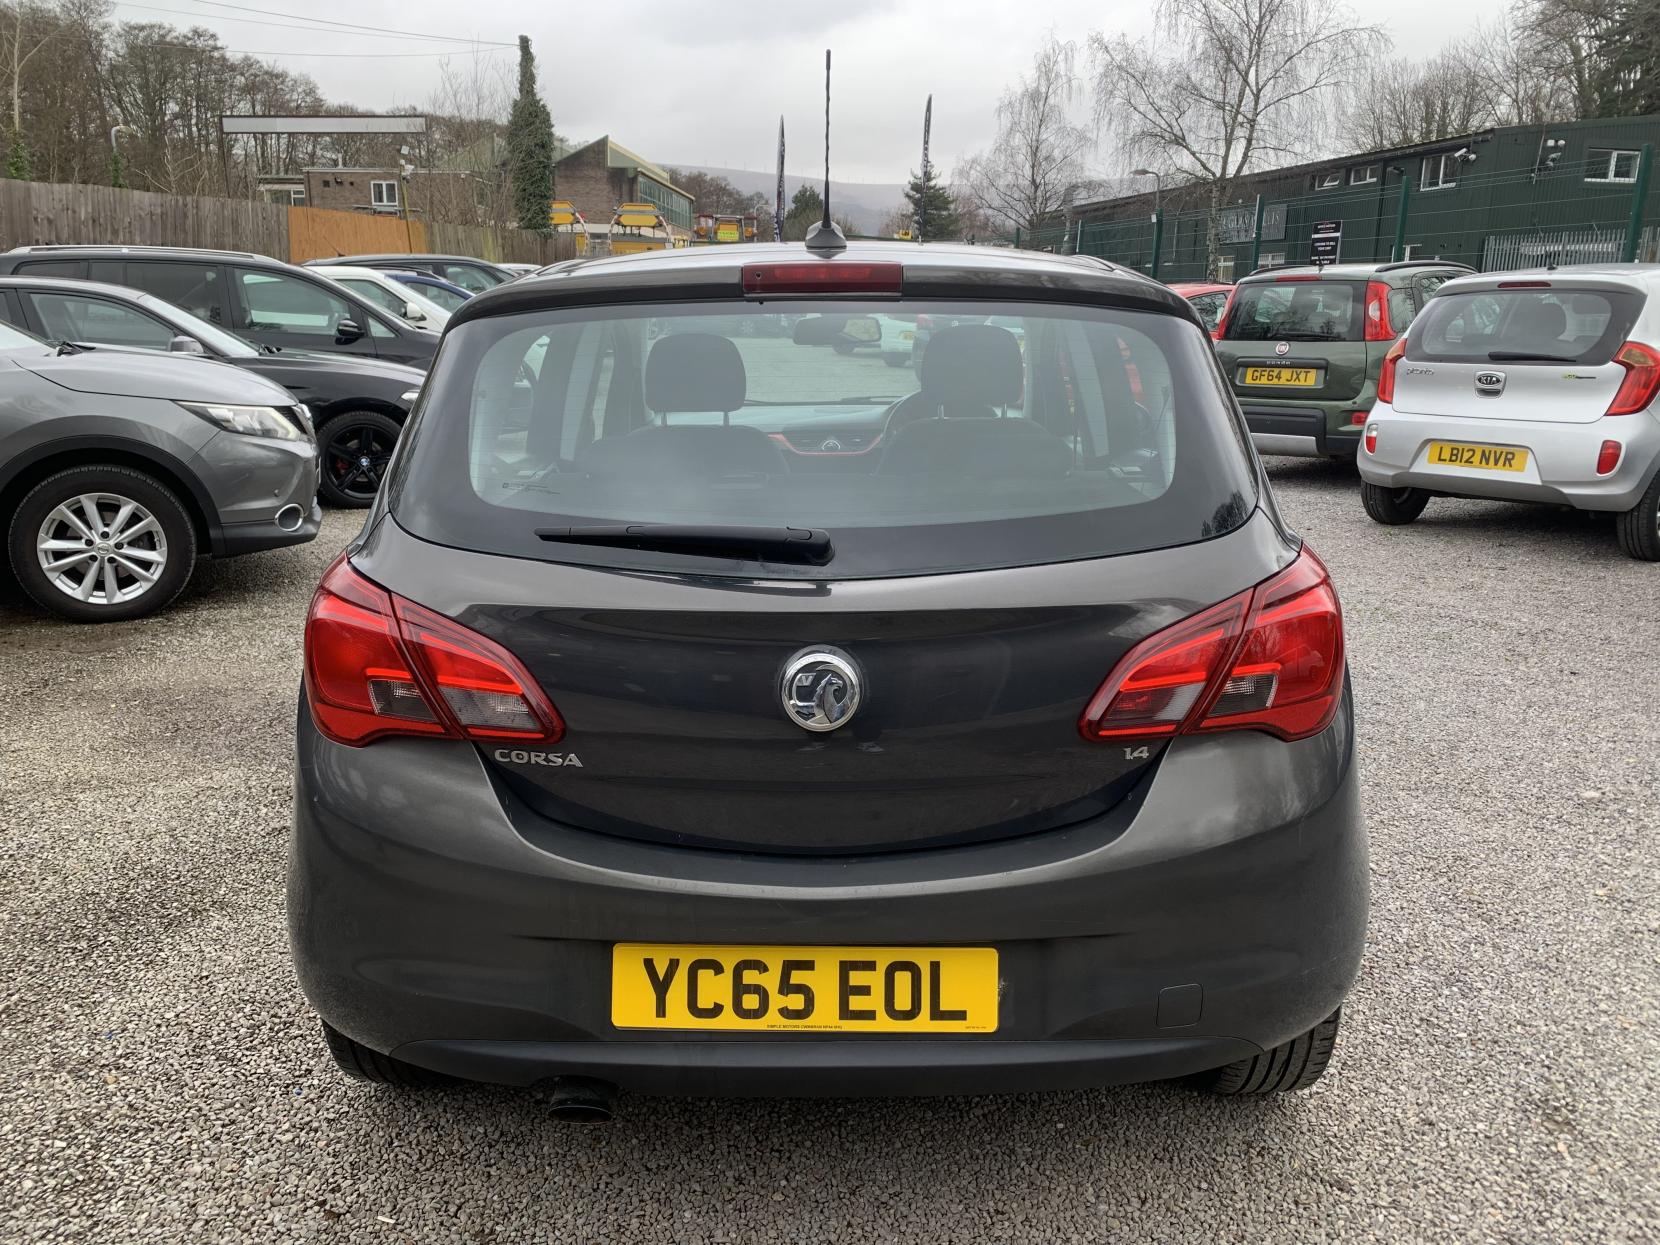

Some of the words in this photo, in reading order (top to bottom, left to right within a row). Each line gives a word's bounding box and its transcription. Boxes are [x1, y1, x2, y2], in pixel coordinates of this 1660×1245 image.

[1251, 369, 1282, 382] GF64
[1286, 370, 1311, 383] JXT
[1437, 446, 1476, 464] LB12
[1479, 448, 1516, 468] NVR
[494, 749, 584, 768] CORSA
[643, 958, 815, 1020] YC65
[838, 960, 967, 1021] EOL
